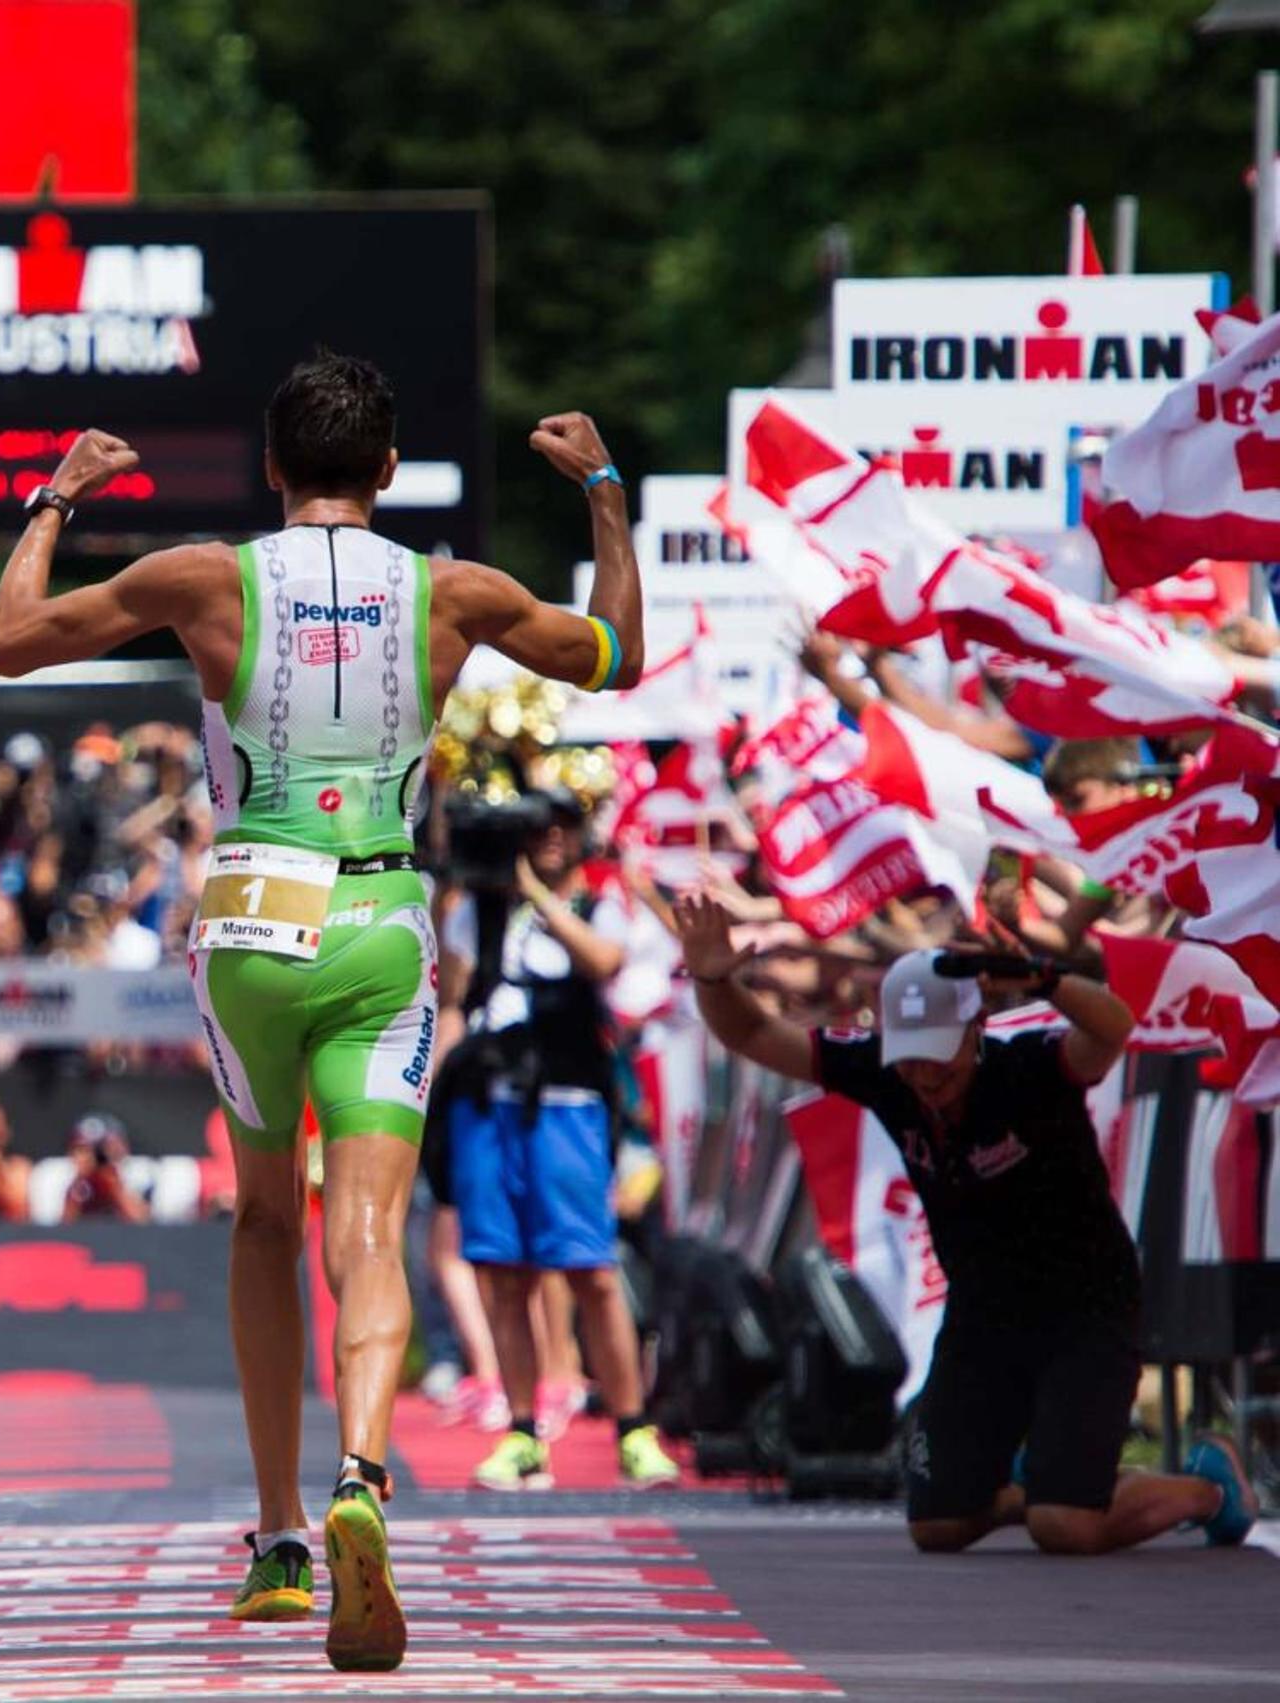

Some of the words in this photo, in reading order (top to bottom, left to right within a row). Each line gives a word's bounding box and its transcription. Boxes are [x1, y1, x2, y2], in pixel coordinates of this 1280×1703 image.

[852, 336, 1184, 381] IRONMAN
[293, 601, 381, 627] pewag
[241, 877, 266, 916] 1
[221, 921, 274, 938] Marino
[402, 1006, 435, 1089] pewag
